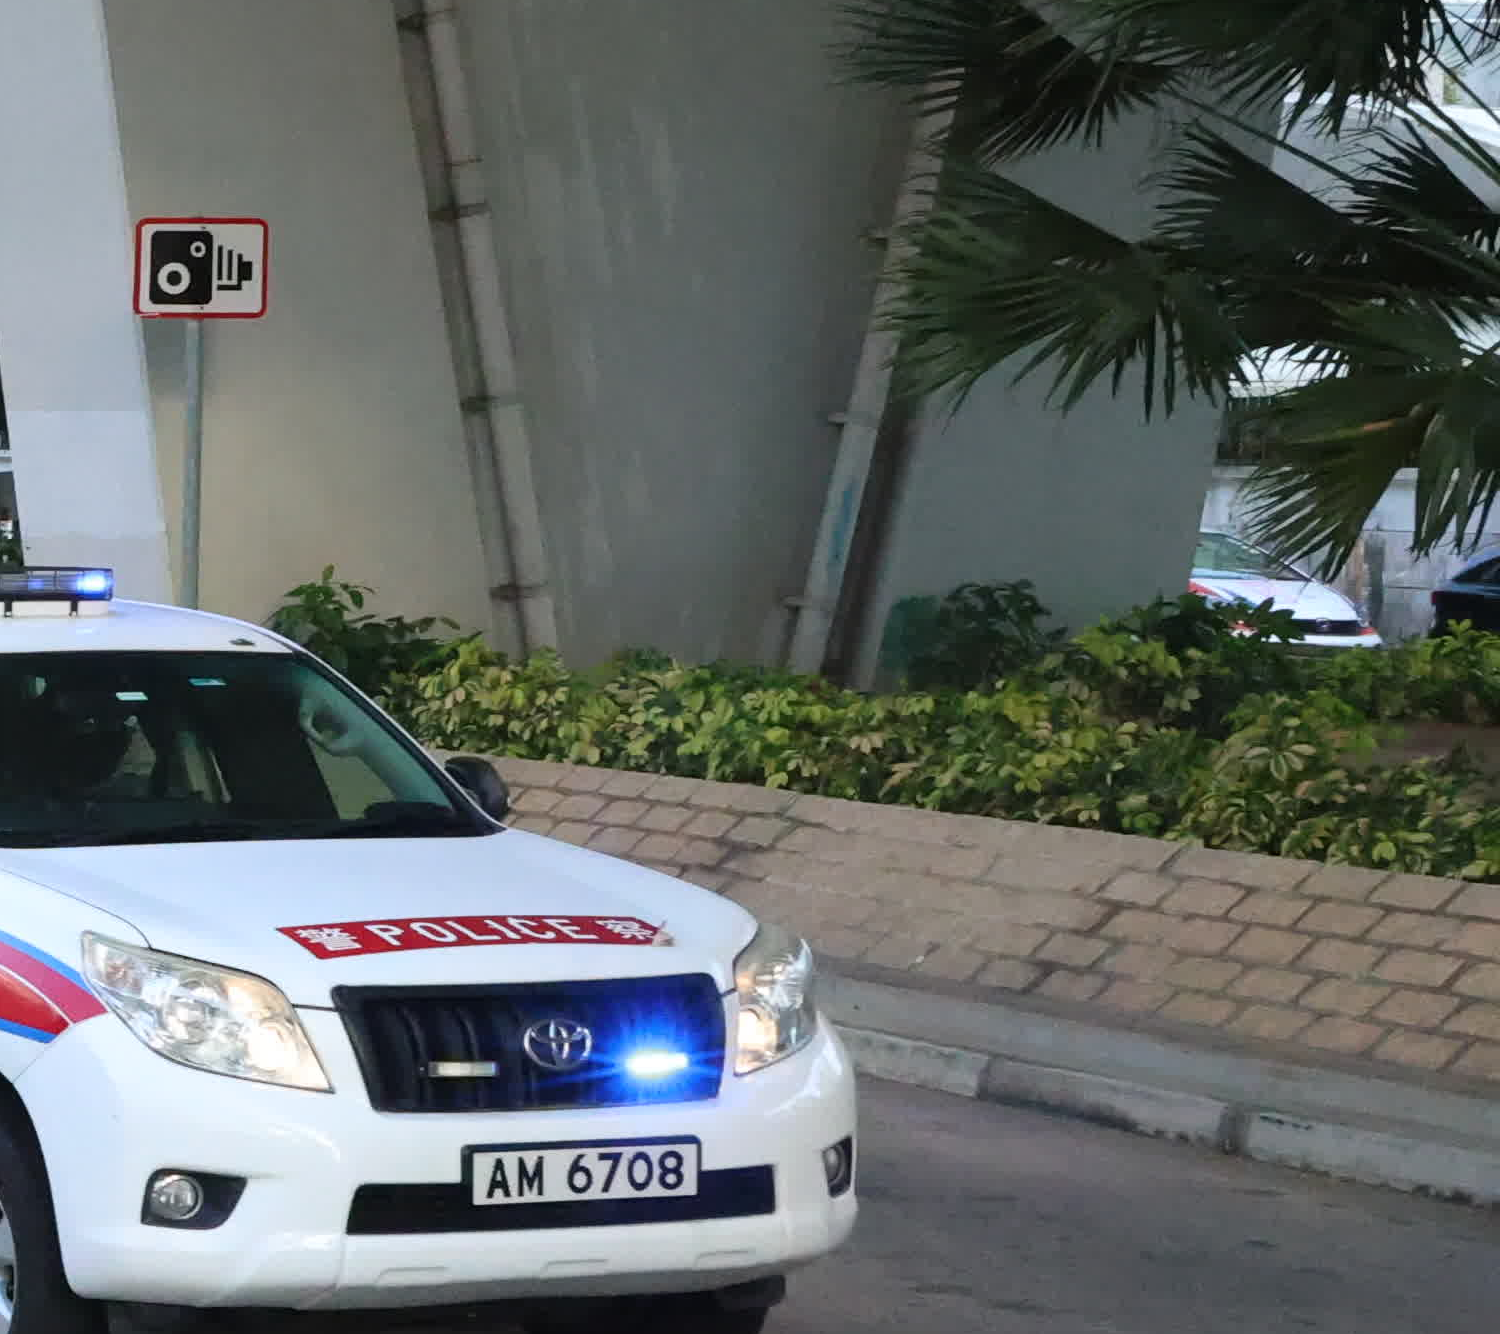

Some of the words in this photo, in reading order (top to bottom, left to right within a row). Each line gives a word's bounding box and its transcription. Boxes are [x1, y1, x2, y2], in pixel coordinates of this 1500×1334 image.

[294, 926, 364, 952] 警
[364, 916, 601, 947] POLICE
[485, 1155, 545, 1199] AM
[566, 1150, 685, 1195] 6708
